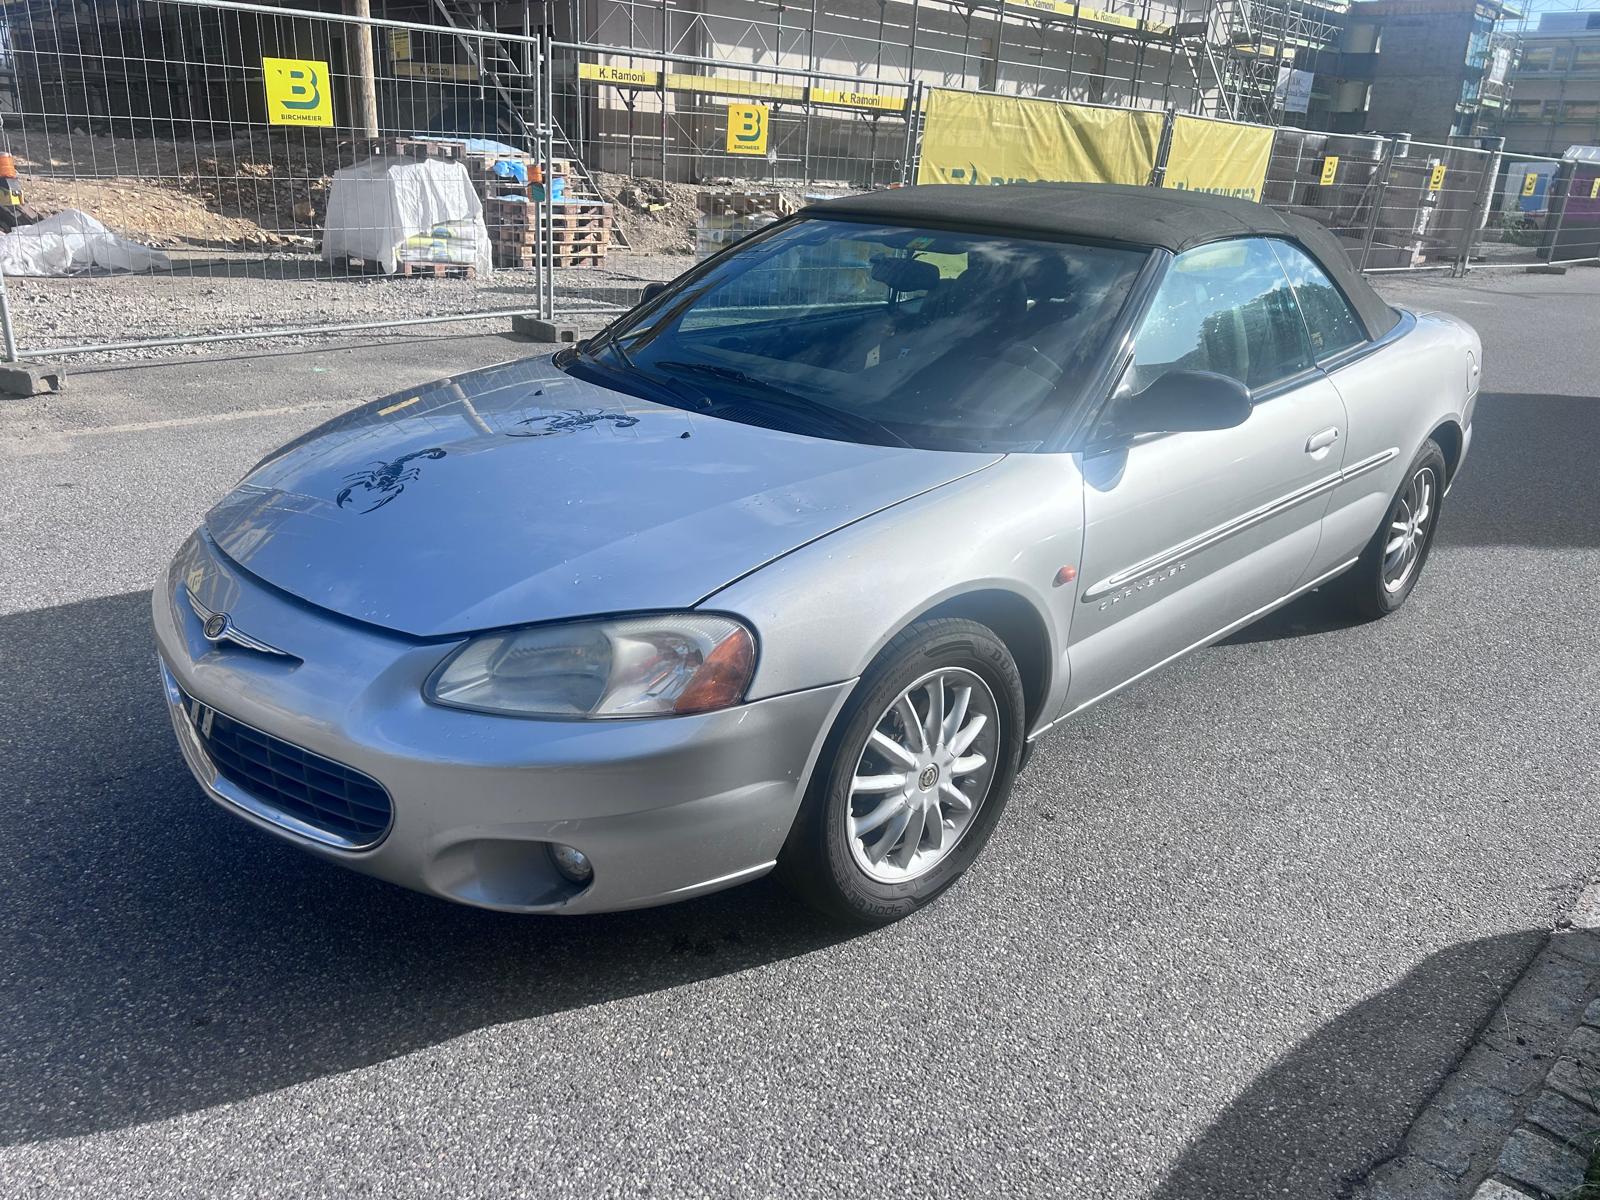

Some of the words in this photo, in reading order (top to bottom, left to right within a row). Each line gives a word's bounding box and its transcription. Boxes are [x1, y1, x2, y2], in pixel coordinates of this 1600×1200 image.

[599, 68, 608, 79] K.
[611, 69, 646, 82] Ramoni
[277, 65, 320, 110] B
[840, 92, 848, 102] K.
[850, 93, 881, 106] Ramoni
[280, 113, 322, 121] BIRCHMEIER
